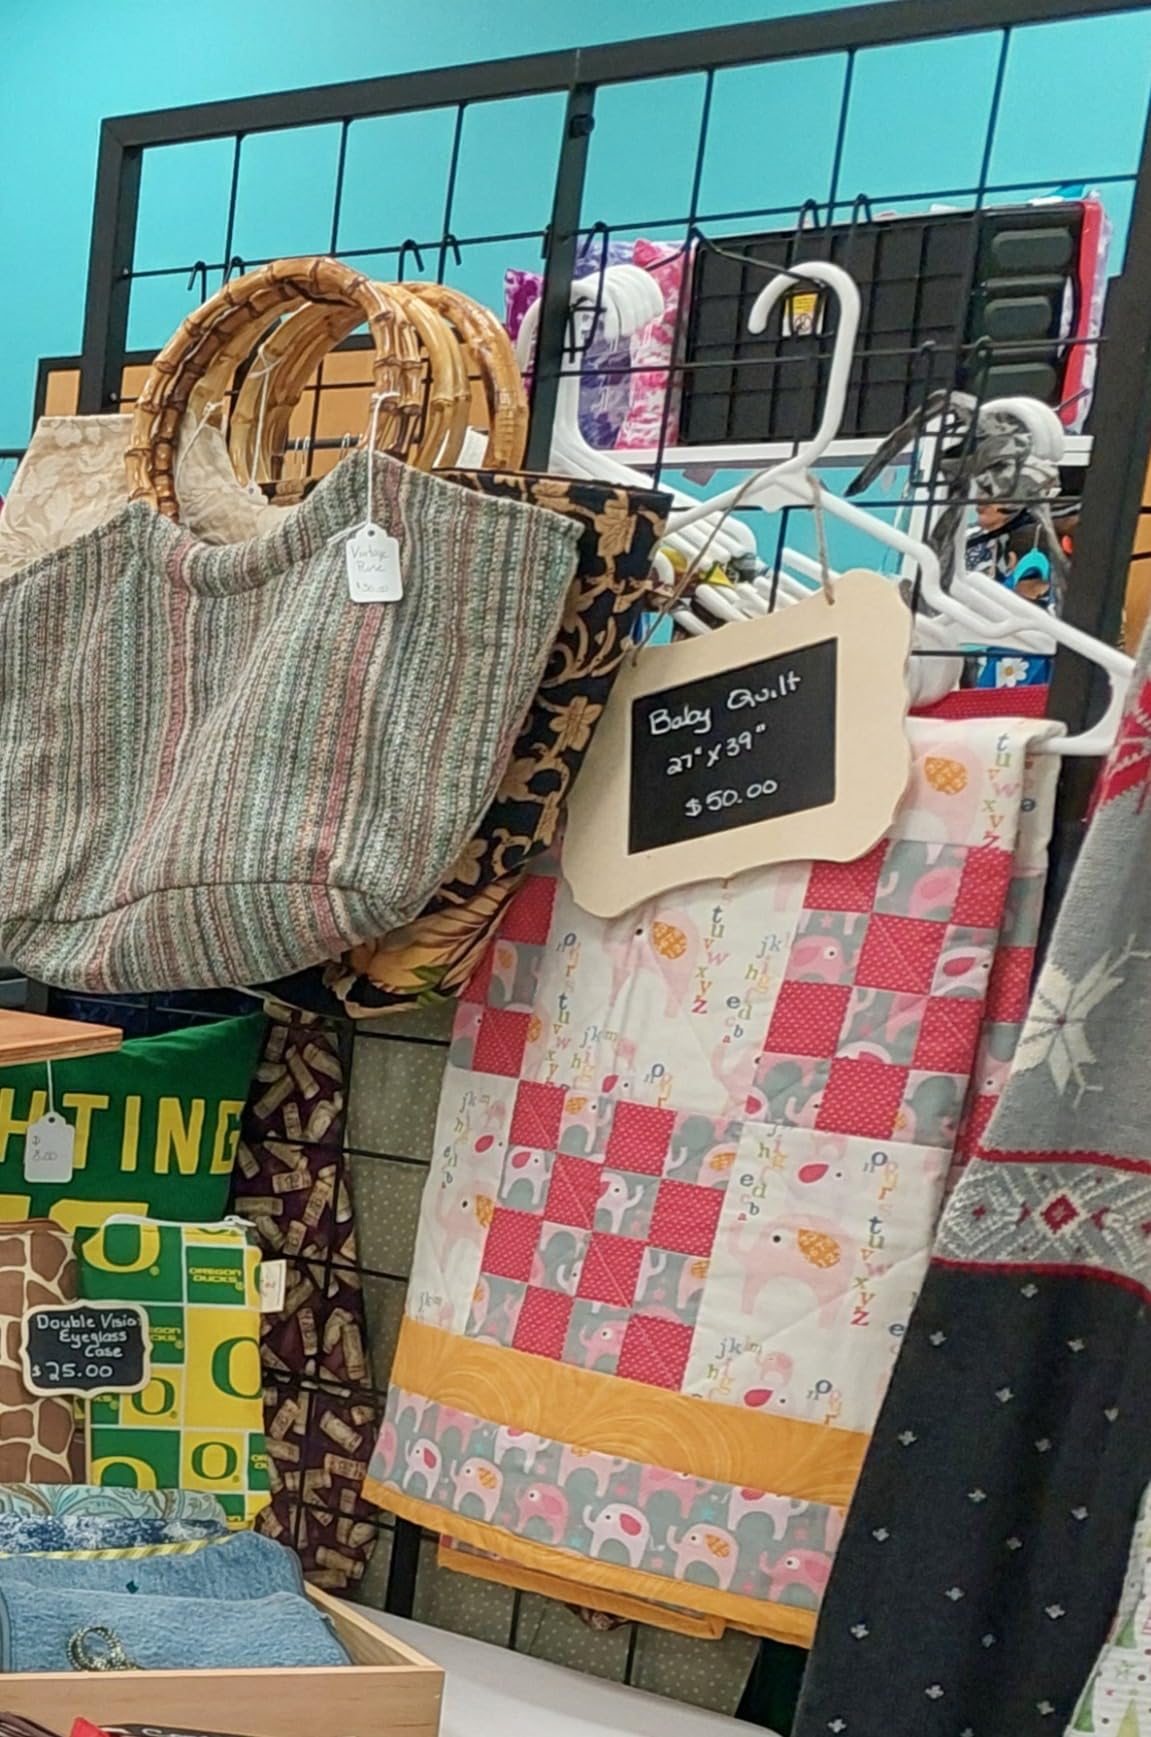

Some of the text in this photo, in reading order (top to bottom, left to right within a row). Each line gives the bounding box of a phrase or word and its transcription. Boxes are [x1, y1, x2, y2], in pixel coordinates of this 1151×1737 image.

[648, 671, 801, 735] Baby Quilt
[685, 780, 778, 817] $50.00
[36, 1314, 96, 1329] Double
[59, 1329, 127, 1348] Eyeglass
[84, 1345, 124, 1357] Case
[191, 1441, 238, 1480] O
